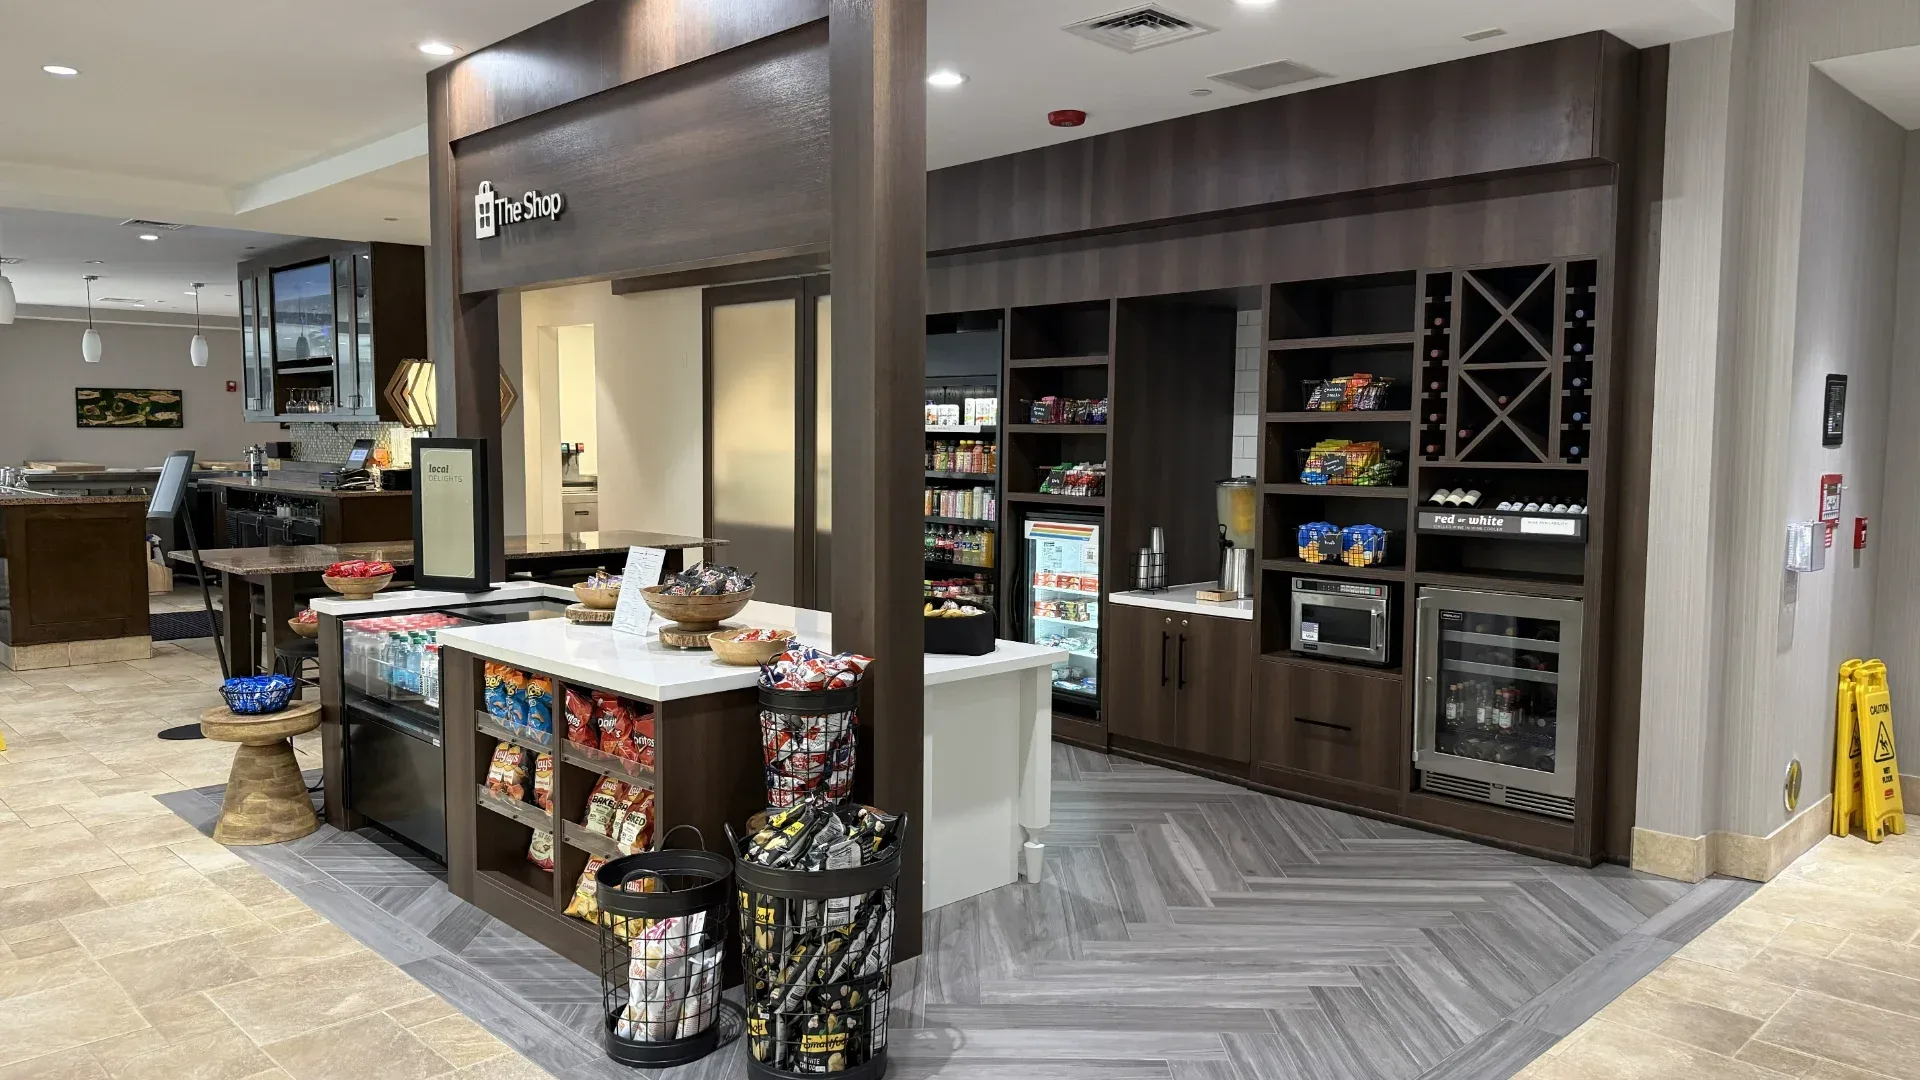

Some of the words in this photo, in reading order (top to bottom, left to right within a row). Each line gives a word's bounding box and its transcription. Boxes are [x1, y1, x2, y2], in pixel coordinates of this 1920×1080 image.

[495, 197, 521, 225] The
[523, 190, 561, 220] Shop
[428, 464, 449, 473] local
[428, 474, 463, 483] DELIGHTS
[1434, 514, 1456, 524] red
[1469, 515, 1504, 526] white
[1869, 703, 1890, 716] CAUTION
[1883, 766, 1891, 775] WET
[1882, 775, 1893, 785] FLOOR
[626, 812, 646, 827] BAKED
